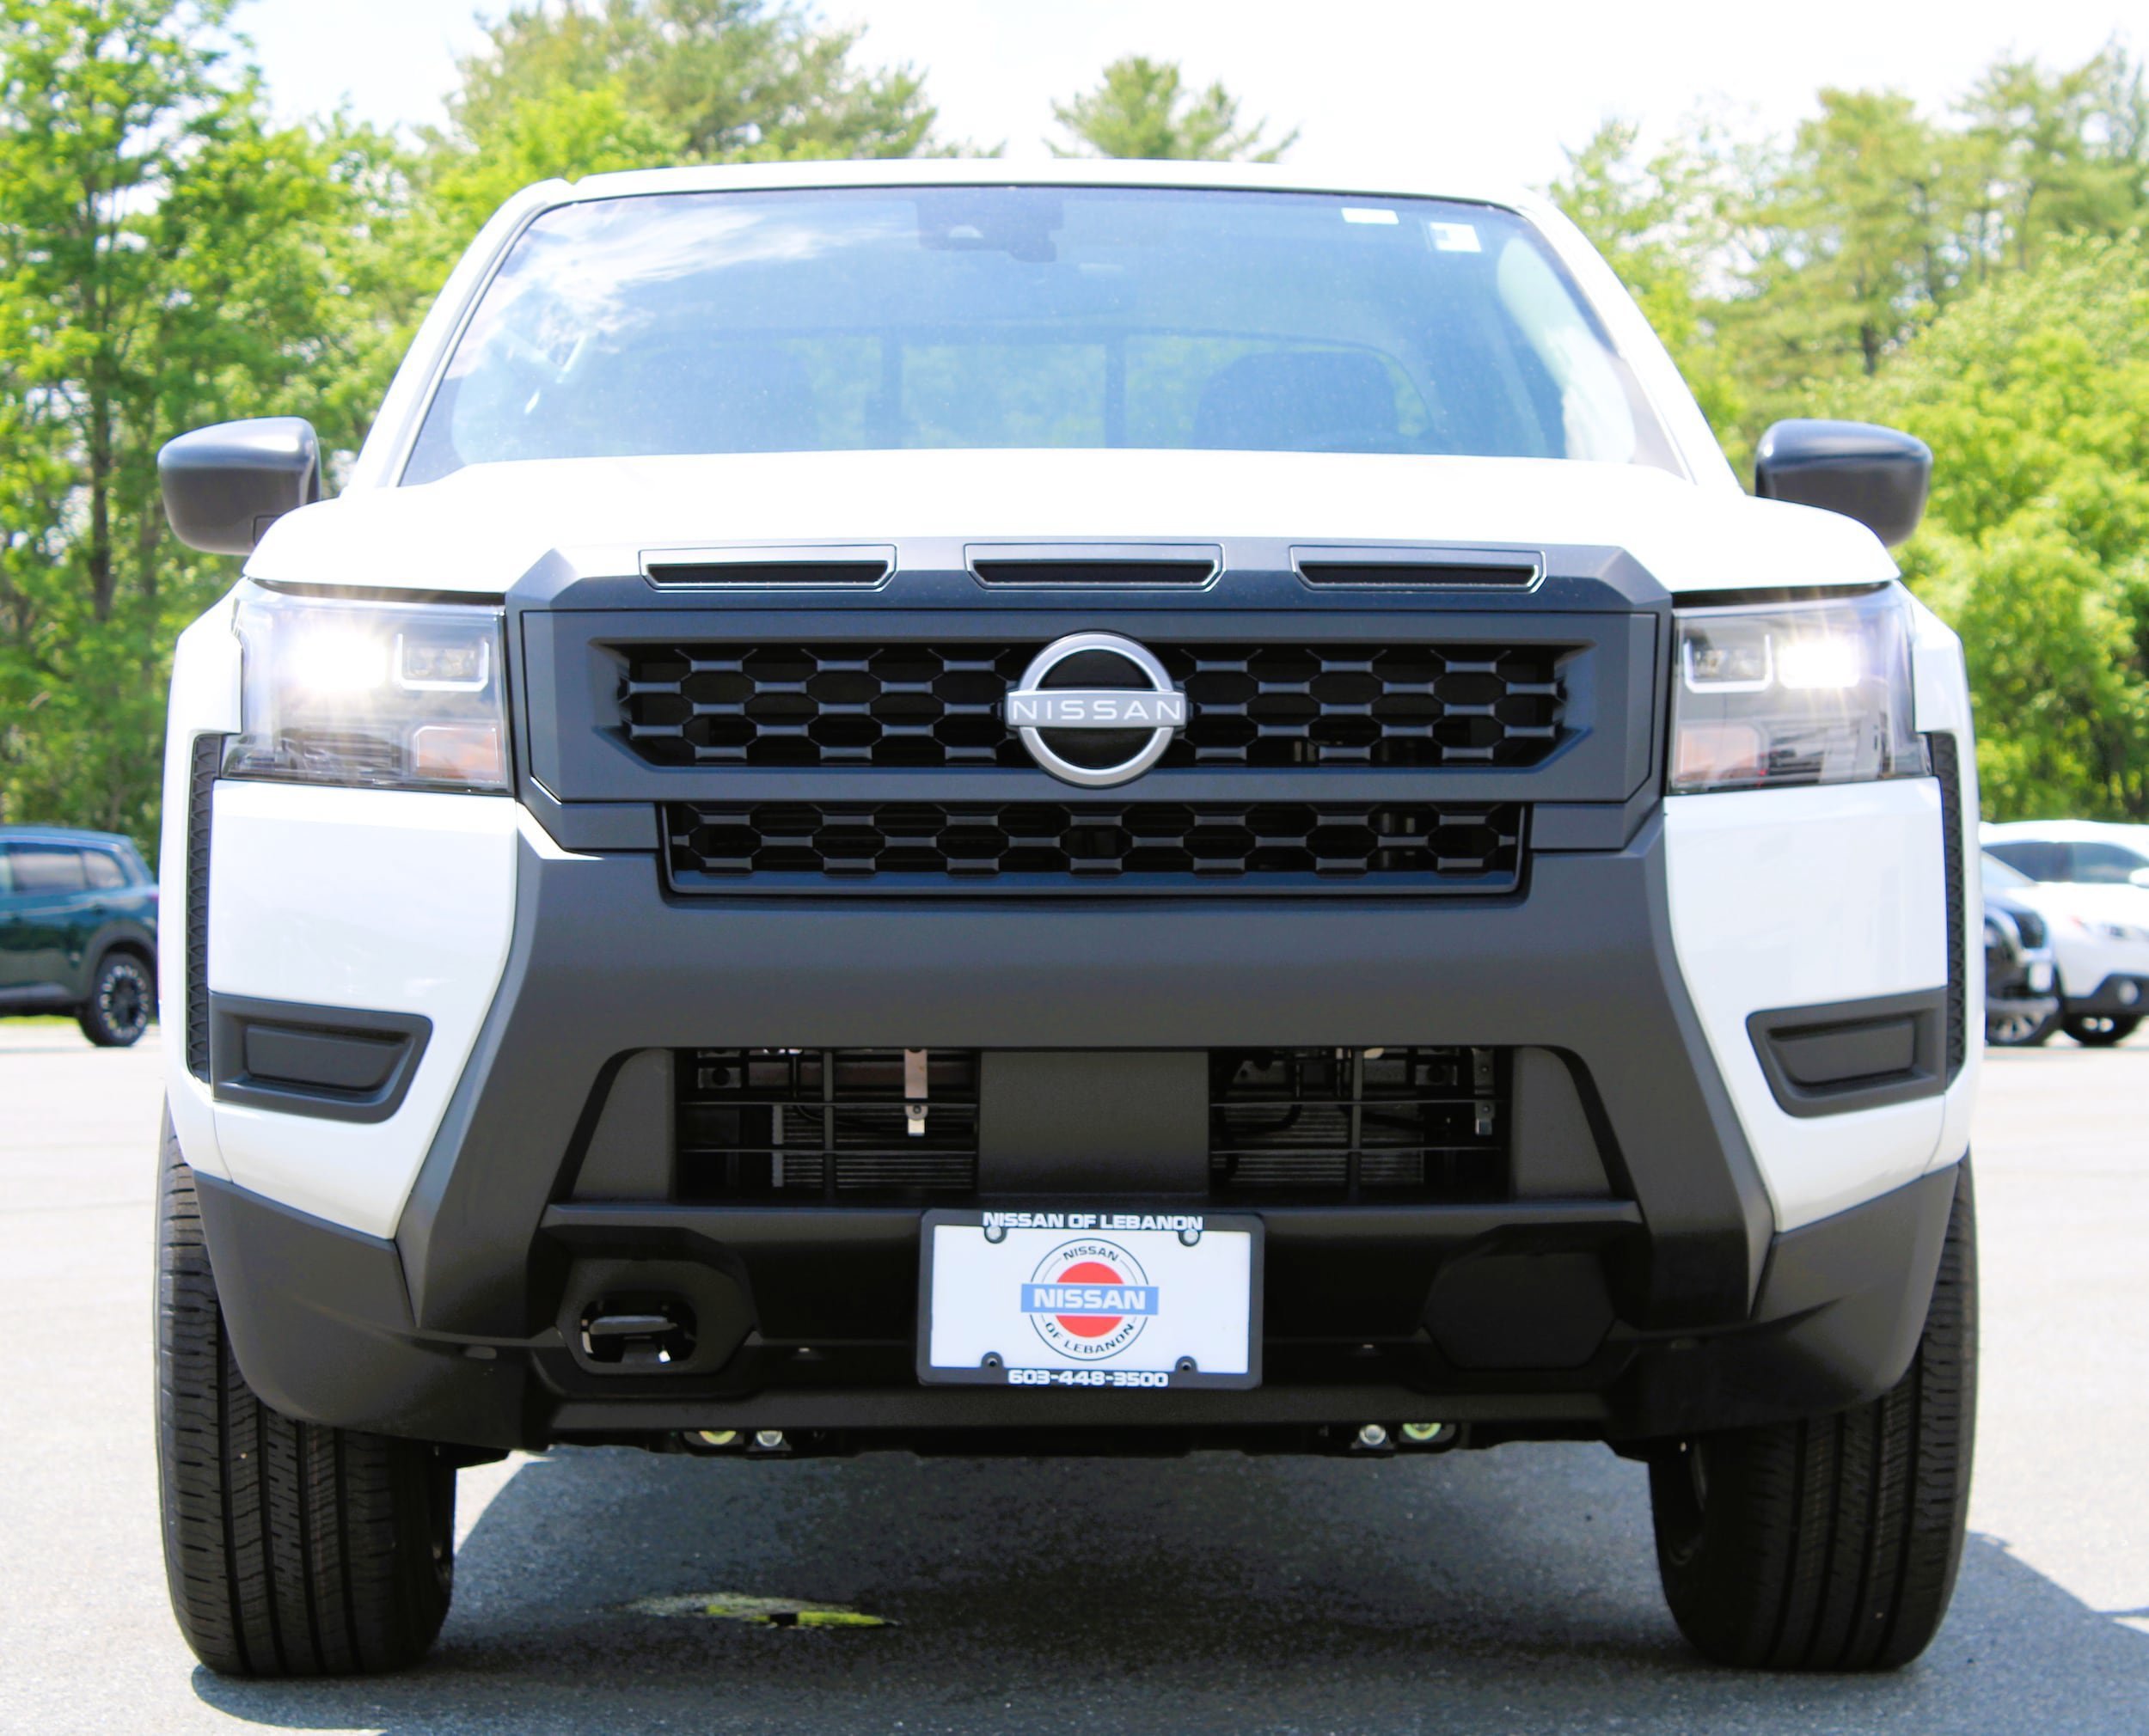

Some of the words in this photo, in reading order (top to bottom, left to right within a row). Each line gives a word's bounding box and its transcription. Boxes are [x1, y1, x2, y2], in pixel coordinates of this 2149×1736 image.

[1013, 700, 1181, 720] NISSAN
[983, 1212, 1064, 1228] NISSAN
[1068, 1214, 1097, 1229] OF
[1100, 1214, 1203, 1231] LEBANON
[1062, 1246, 1119, 1262] NISSAN
[1034, 1289, 1145, 1310] NISSAN
[1045, 1323, 1063, 1340] OF
[1065, 1323, 1134, 1354] LEBANON
[1008, 1369, 1168, 1388] 603-448-3500
